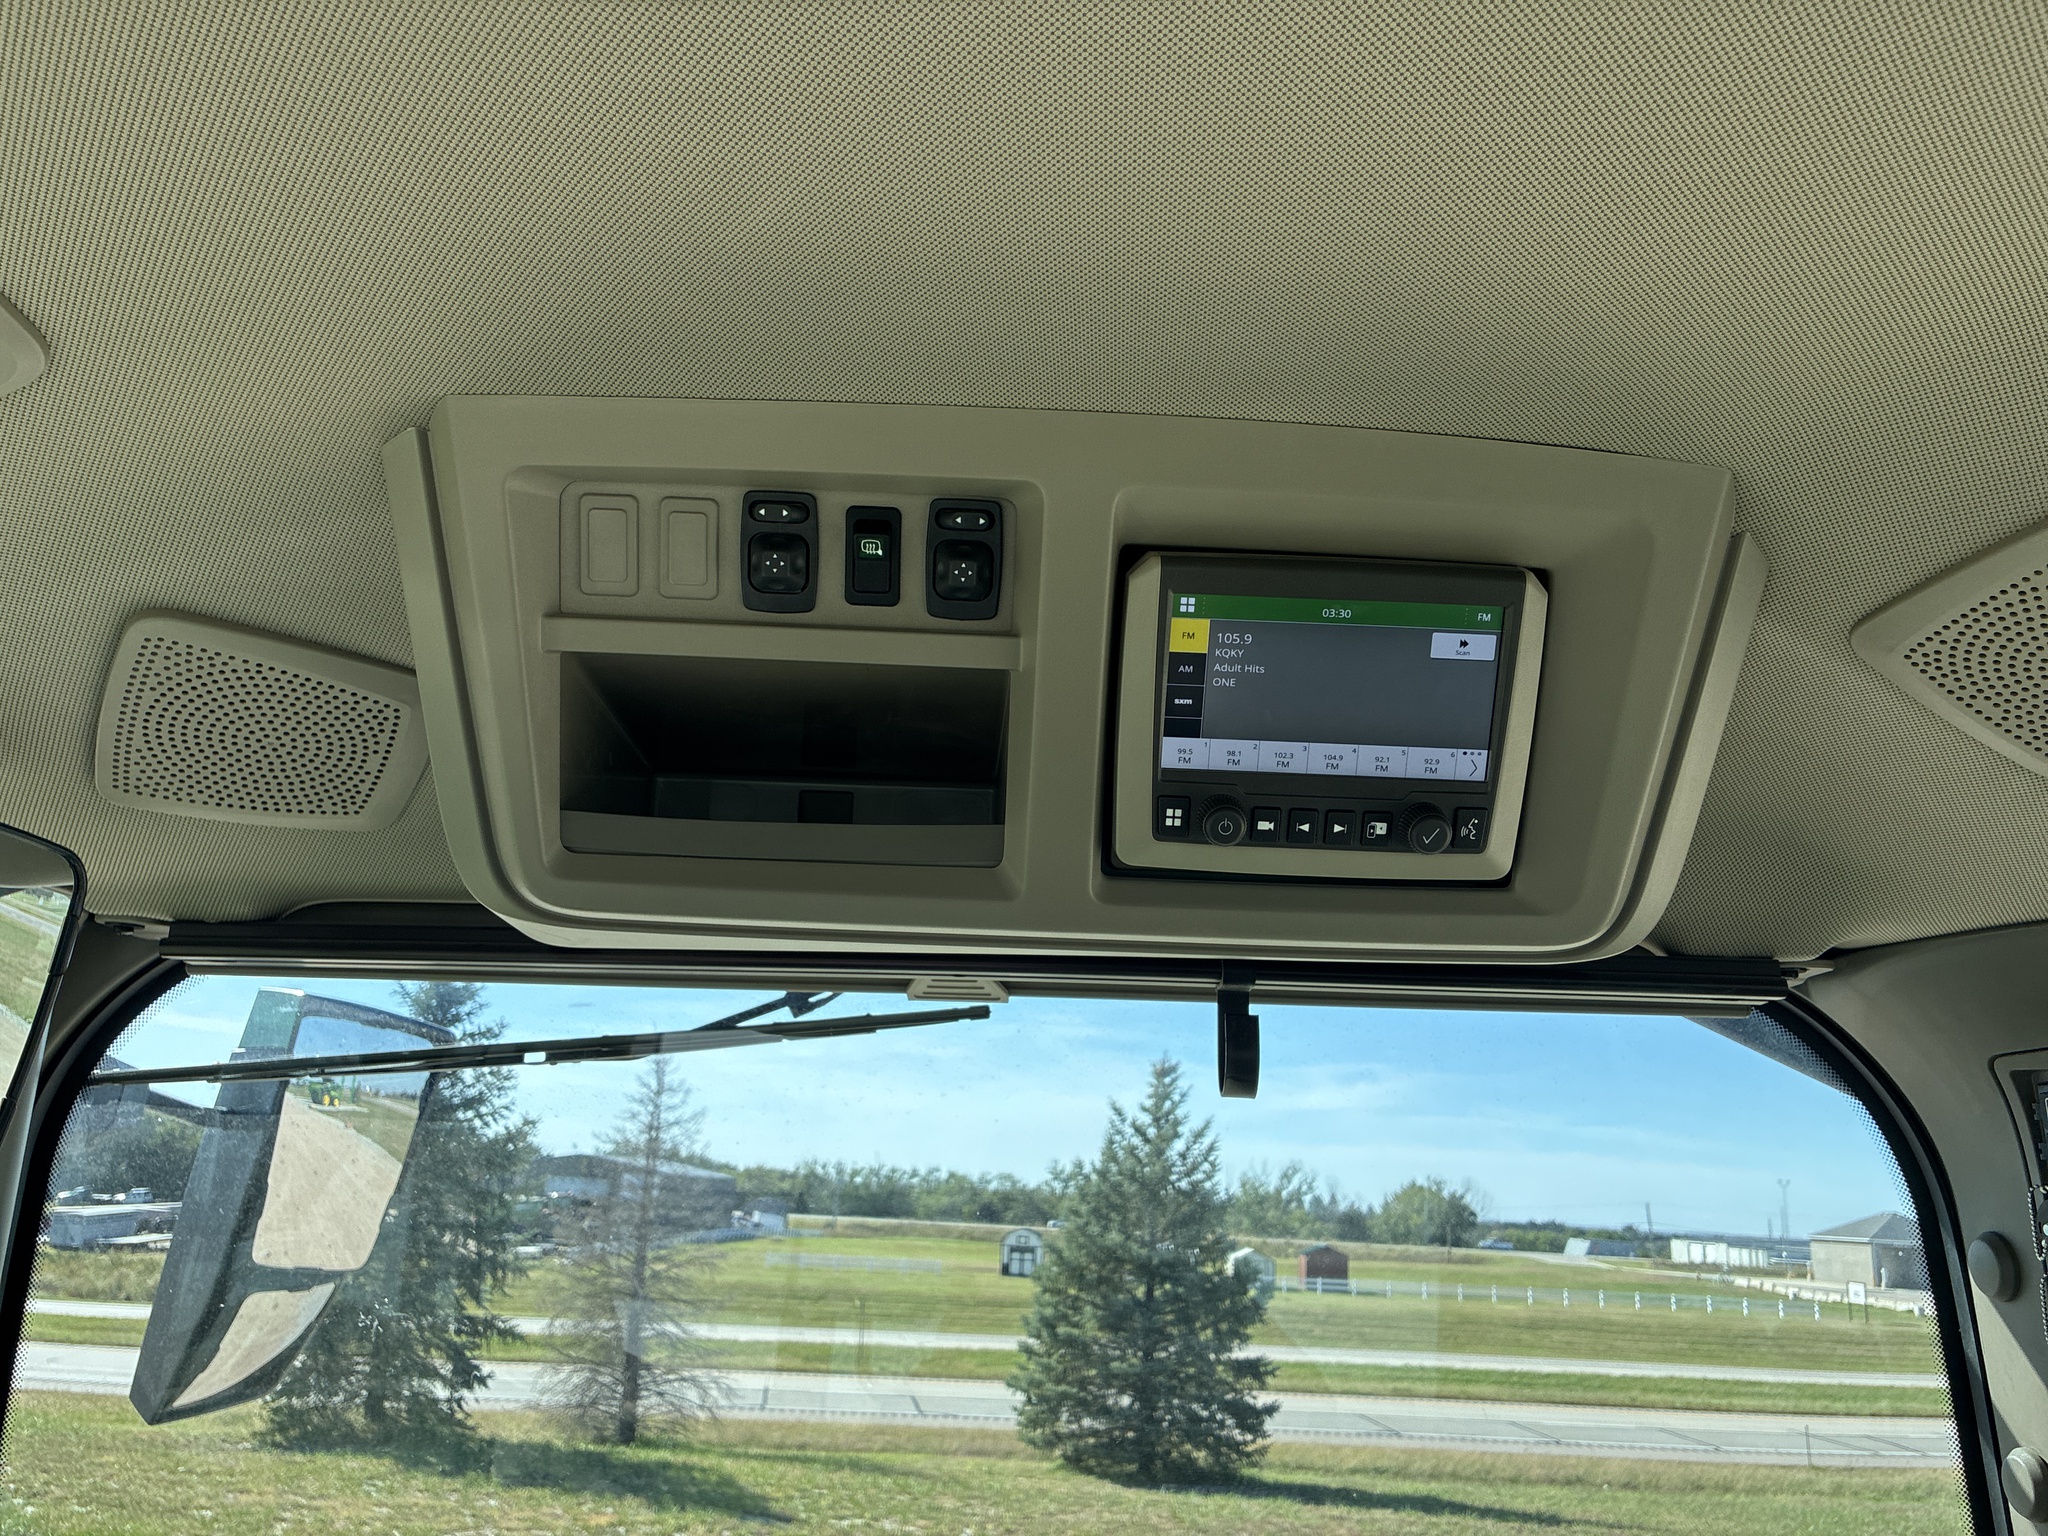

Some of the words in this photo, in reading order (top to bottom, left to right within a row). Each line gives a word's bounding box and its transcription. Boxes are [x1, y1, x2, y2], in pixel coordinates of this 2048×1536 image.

[1322, 608, 1352, 619] 03:30
[1477, 612, 1492, 622] FM
[1181, 631, 1196, 640] FM
[1217, 632, 1253, 645] 105.9
[1214, 648, 1245, 659] KQKY
[1177, 664, 1194, 673] AM
[1213, 662, 1242, 673] Adult
[1244, 664, 1265, 674] Hits
[1212, 677, 1237, 687] ONE
[1177, 756, 1192, 764] FM
[1274, 752, 1294, 760] 102.3
[1323, 754, 1344, 762] 104.9
[1227, 758, 1241, 766] FM
[1276, 760, 1290, 768] FM
[1325, 762, 1339, 770] FM
[1423, 758, 1440, 766] 92.9
[1375, 764, 1389, 772] FM
[1424, 766, 1438, 774] FM
